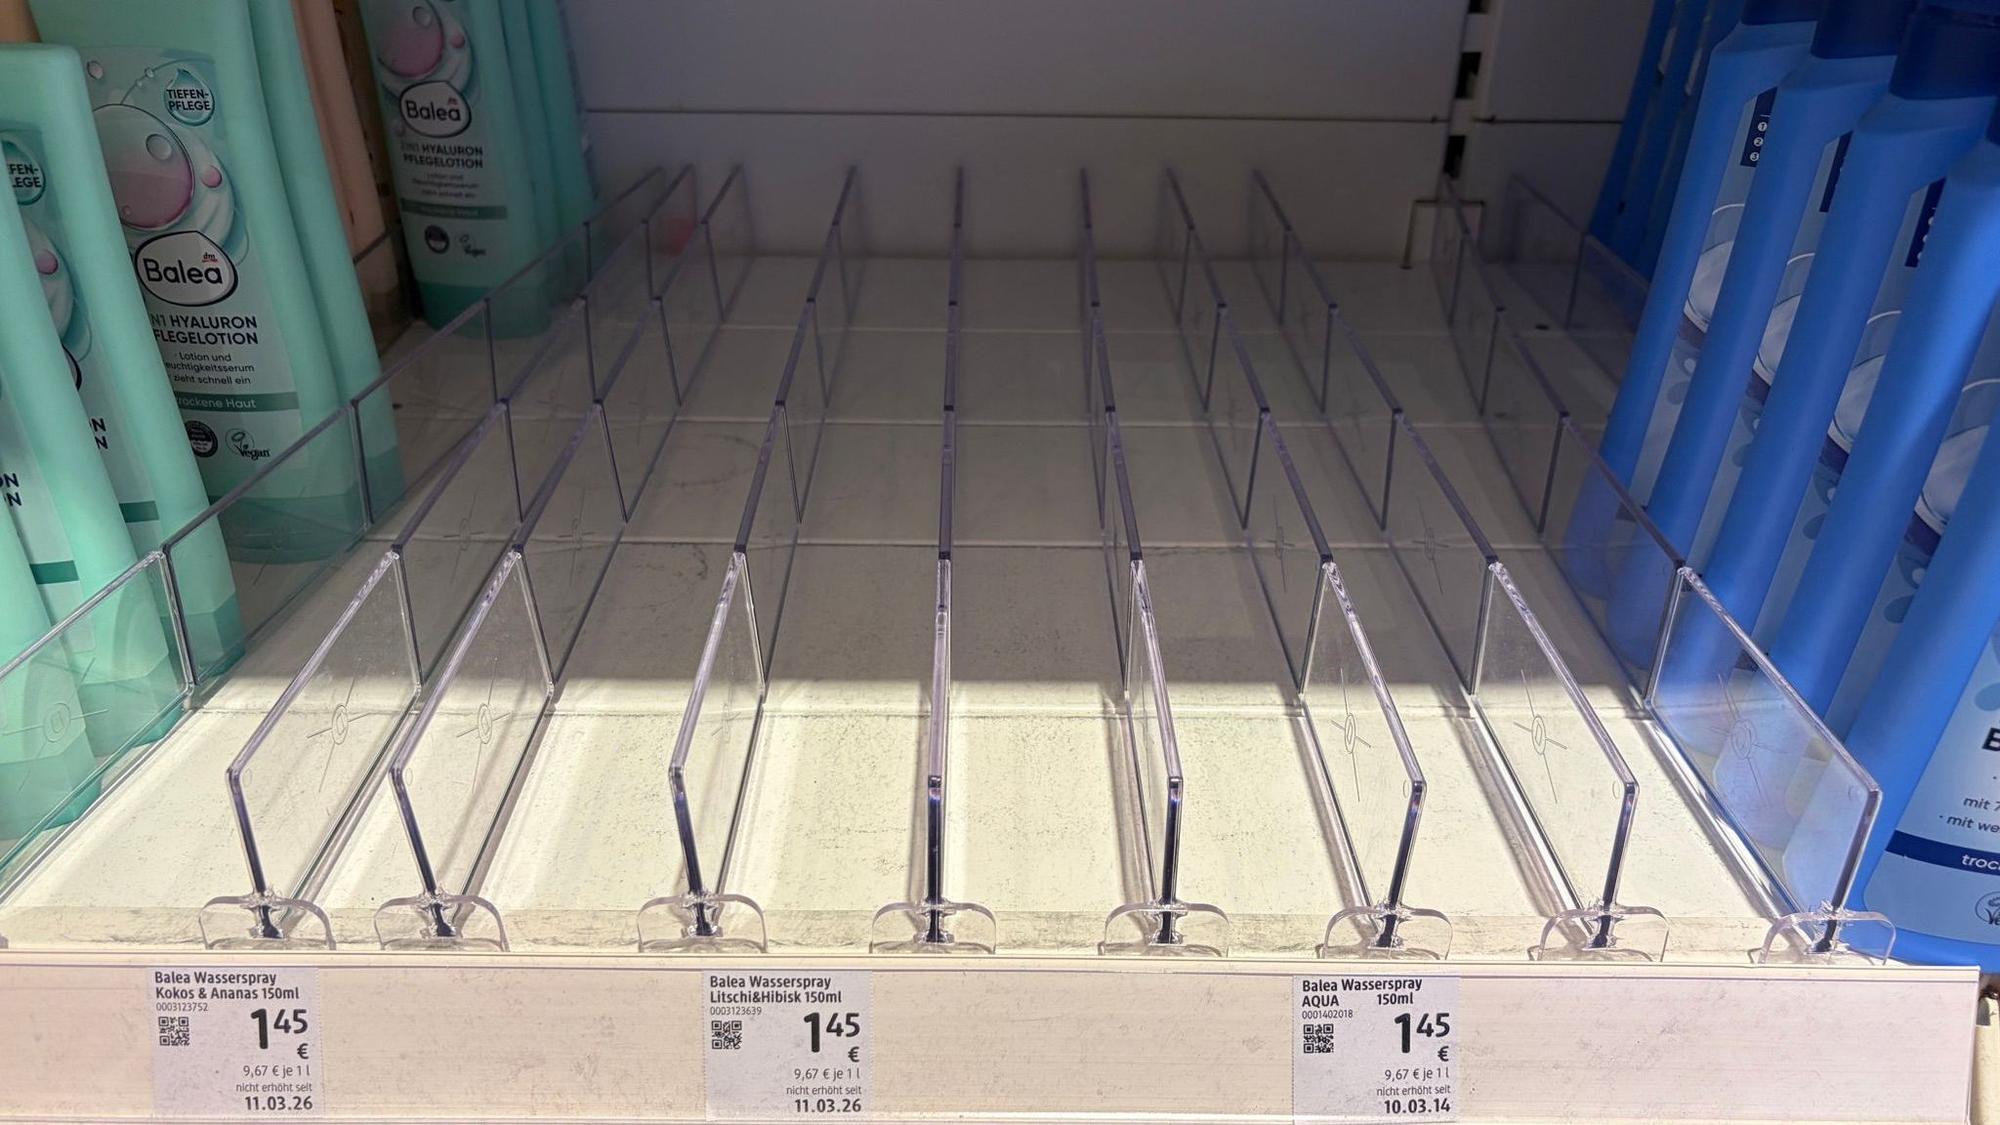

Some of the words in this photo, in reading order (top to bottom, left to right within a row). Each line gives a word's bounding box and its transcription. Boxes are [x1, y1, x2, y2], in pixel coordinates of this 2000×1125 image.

[166, 88, 209, 100] TIEFEN-
[168, 101, 211, 111] PFLEGE
[405, 100, 461, 121] Balea
[421, 143, 484, 156] HYALURON
[403, 153, 484, 168] PFLEGELOTION
[8, 163, 39, 175] FEN-
[143, 258, 223, 284] Balea
[150, 313, 167, 327] N1
[170, 315, 257, 329] HYALURON
[153, 328, 259, 345] FLEGELOTION
[179, 352, 209, 362] Lotion
[211, 353, 232, 362] und
[165, 361, 255, 373] euchtigkeitsserum
[198, 375, 232, 385] schnell
[234, 376, 251, 385] ein
[178, 397, 223, 408] rockene
[225, 398, 257, 409] Haut
[1963, 797, 1990, 810] mit
[1946, 815, 1974, 829] mit
[155, 971, 190, 984] Balea
[194, 971, 277, 986] Wasserspray
[710, 975, 746, 988] Balea
[749, 975, 831, 990] Wasserspray
[1302, 979, 1338, 992] Balea
[1341, 978, 1422, 991] Wasserspray
[156, 987, 195, 1000] Kokos
[198, 988, 208, 1000] &
[211, 988, 258, 1000] Ananas
[262, 987, 299, 1000] 150ml
[710, 991, 802, 1004] Litschi&Hibisk
[805, 991, 842, 1004] 150ml
[1302, 995, 1339, 1008] AQUA
[1377, 992, 1414, 1006] 150ml
[156, 1002, 208, 1012] 0003123752
[710, 1006, 762, 1016] 0003123639
[1302, 1009, 1354, 1020] 0001402018
[297, 1043, 309, 1060] €
[848, 1046, 860, 1063] €
[1437, 1046, 1449, 1062] €
[243, 1065, 268, 1078] 9,67
[272, 1066, 280, 1077] €
[282, 1065, 293, 1079] je
[297, 1065, 302, 1076] 1
[794, 1068, 819, 1081] 9,67
[823, 1068, 830, 1079] €
[832, 1068, 843, 1082] je
[847, 1068, 852, 1079] 1
[1384, 1069, 1409, 1082] 9,67
[1413, 1068, 1420, 1079] €
[1422, 1068, 1433, 1082] je
[1437, 1068, 1441, 1079] 1
[236, 1082, 259, 1092] nicht
[262, 1082, 293, 1092] erhöht
[296, 1082, 312, 1092] seit
[786, 1085, 809, 1095] nicht
[811, 1085, 843, 1095] erhöht
[845, 1085, 862, 1095] seit
[1376, 1086, 1399, 1096] nicht
[1402, 1086, 1432, 1096] erhöht
[1434, 1085, 1451, 1094] seit
[245, 1095, 313, 1111] 11.03.26
[795, 1098, 862, 1113] 11.03.26
[1384, 1098, 1451, 1114] 10.03.14
